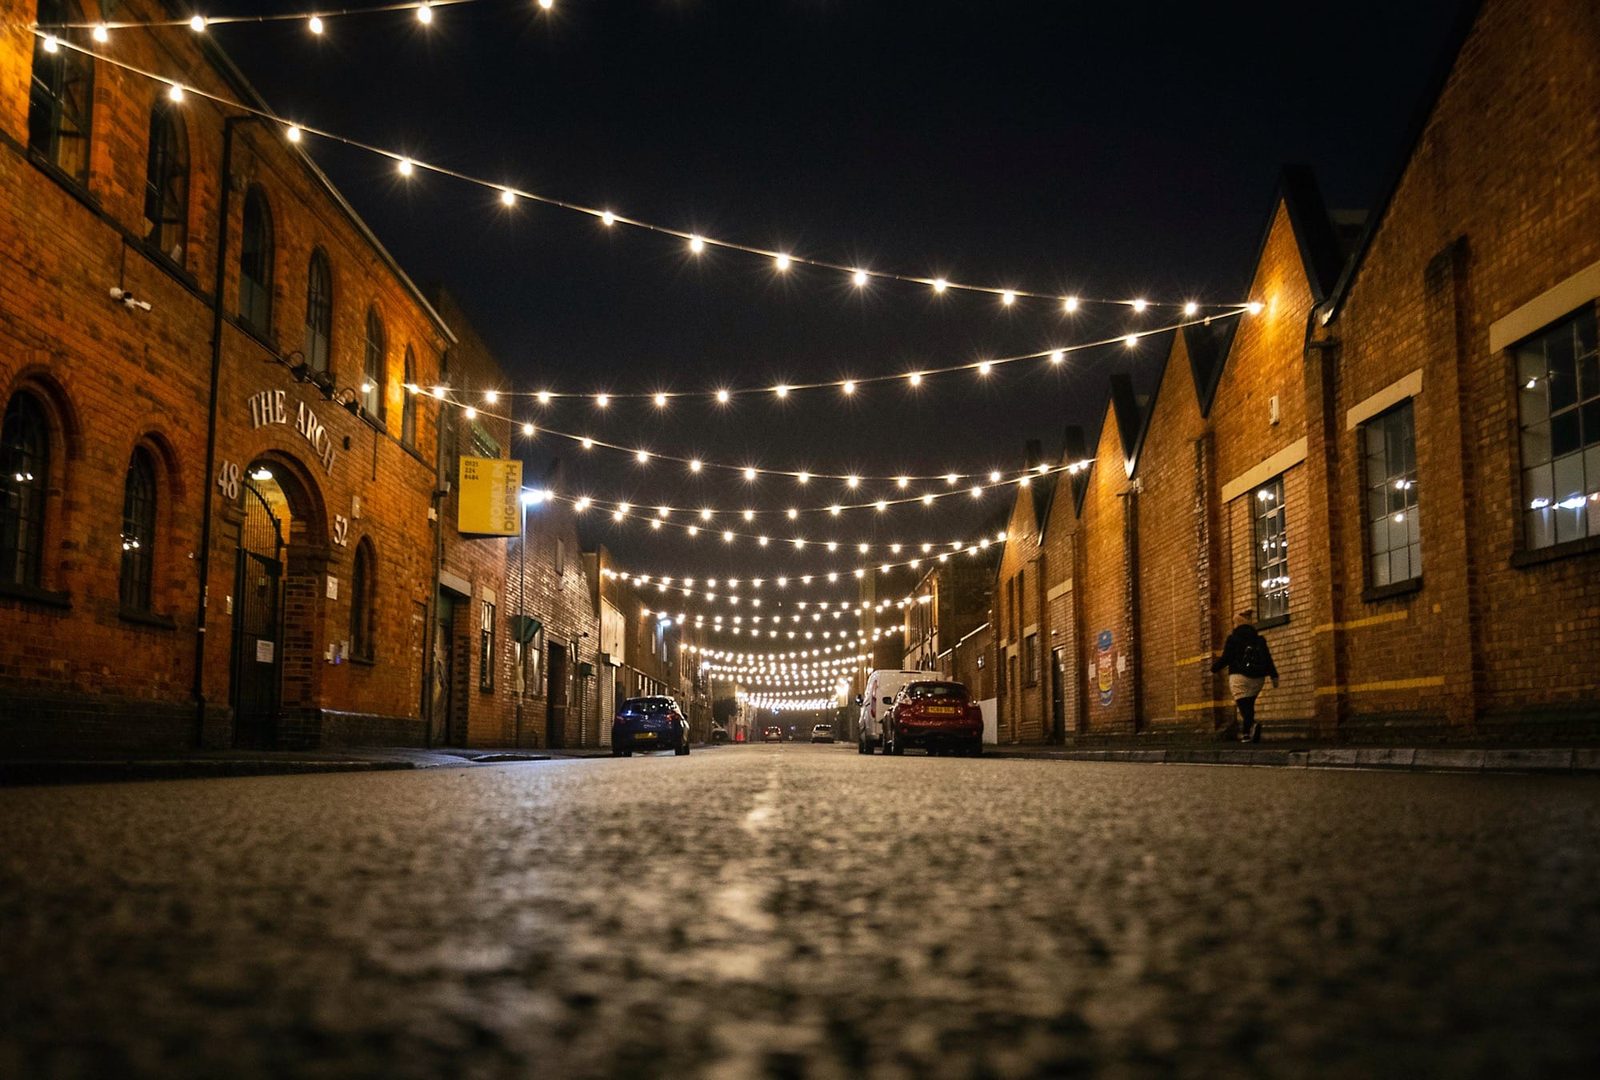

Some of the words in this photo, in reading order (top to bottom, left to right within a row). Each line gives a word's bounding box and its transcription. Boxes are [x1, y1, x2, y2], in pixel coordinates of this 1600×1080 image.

[248, 390, 287, 429] THE
[295, 401, 337, 476] ARCH
[217, 459, 240, 501] 48
[503, 464, 517, 532] DIGBETH
[334, 514, 348, 547] 52
